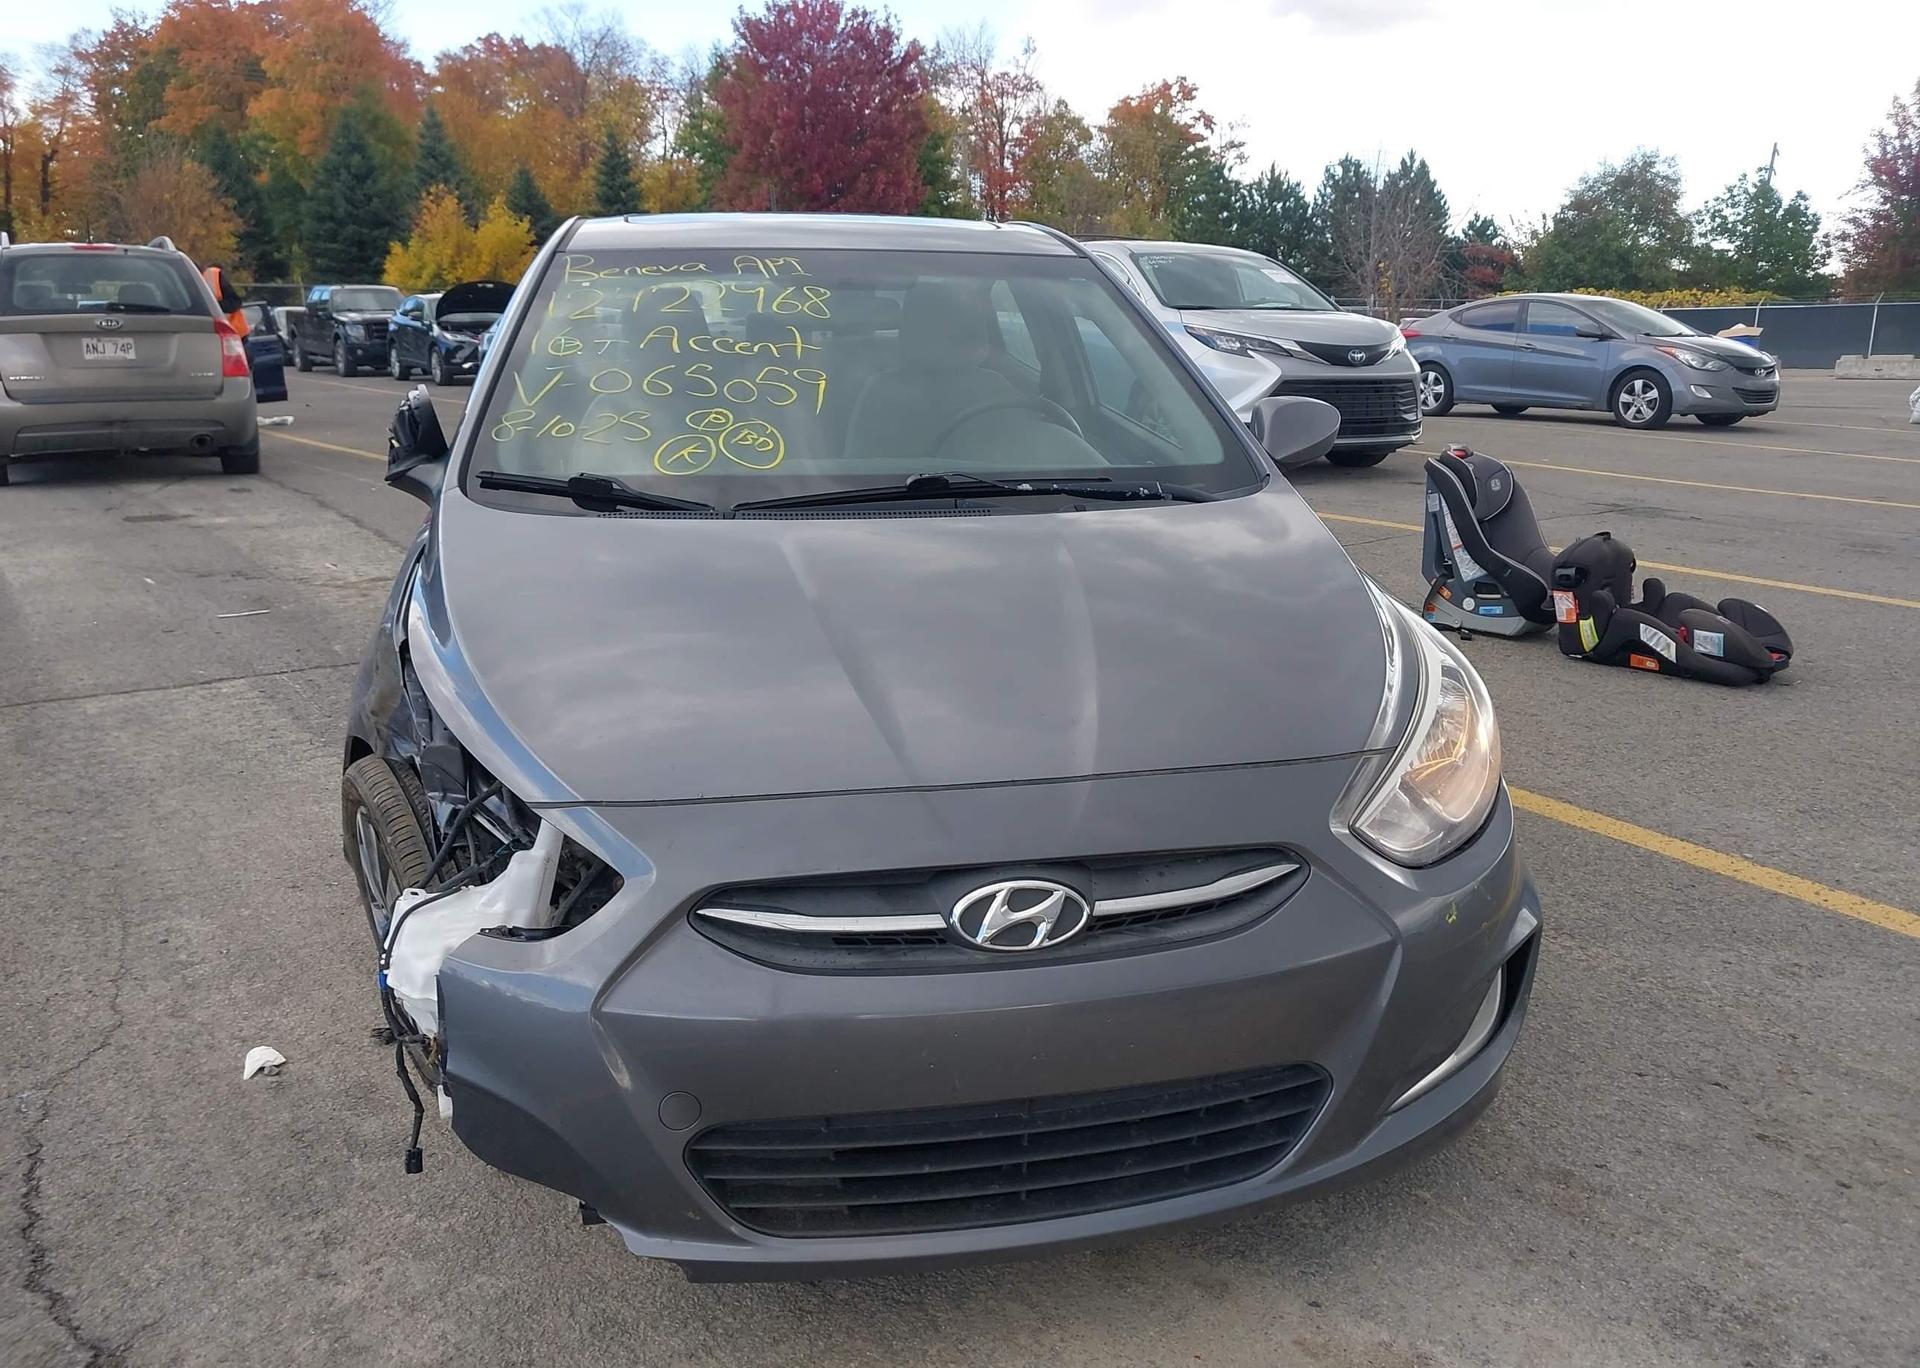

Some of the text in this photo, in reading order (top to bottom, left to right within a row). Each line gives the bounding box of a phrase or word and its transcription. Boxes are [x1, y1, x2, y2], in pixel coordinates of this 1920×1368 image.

[564, 254, 712, 284] Beneva
[85, 342, 133, 355] ANJ 74P
[639, 325, 823, 361] Accent
